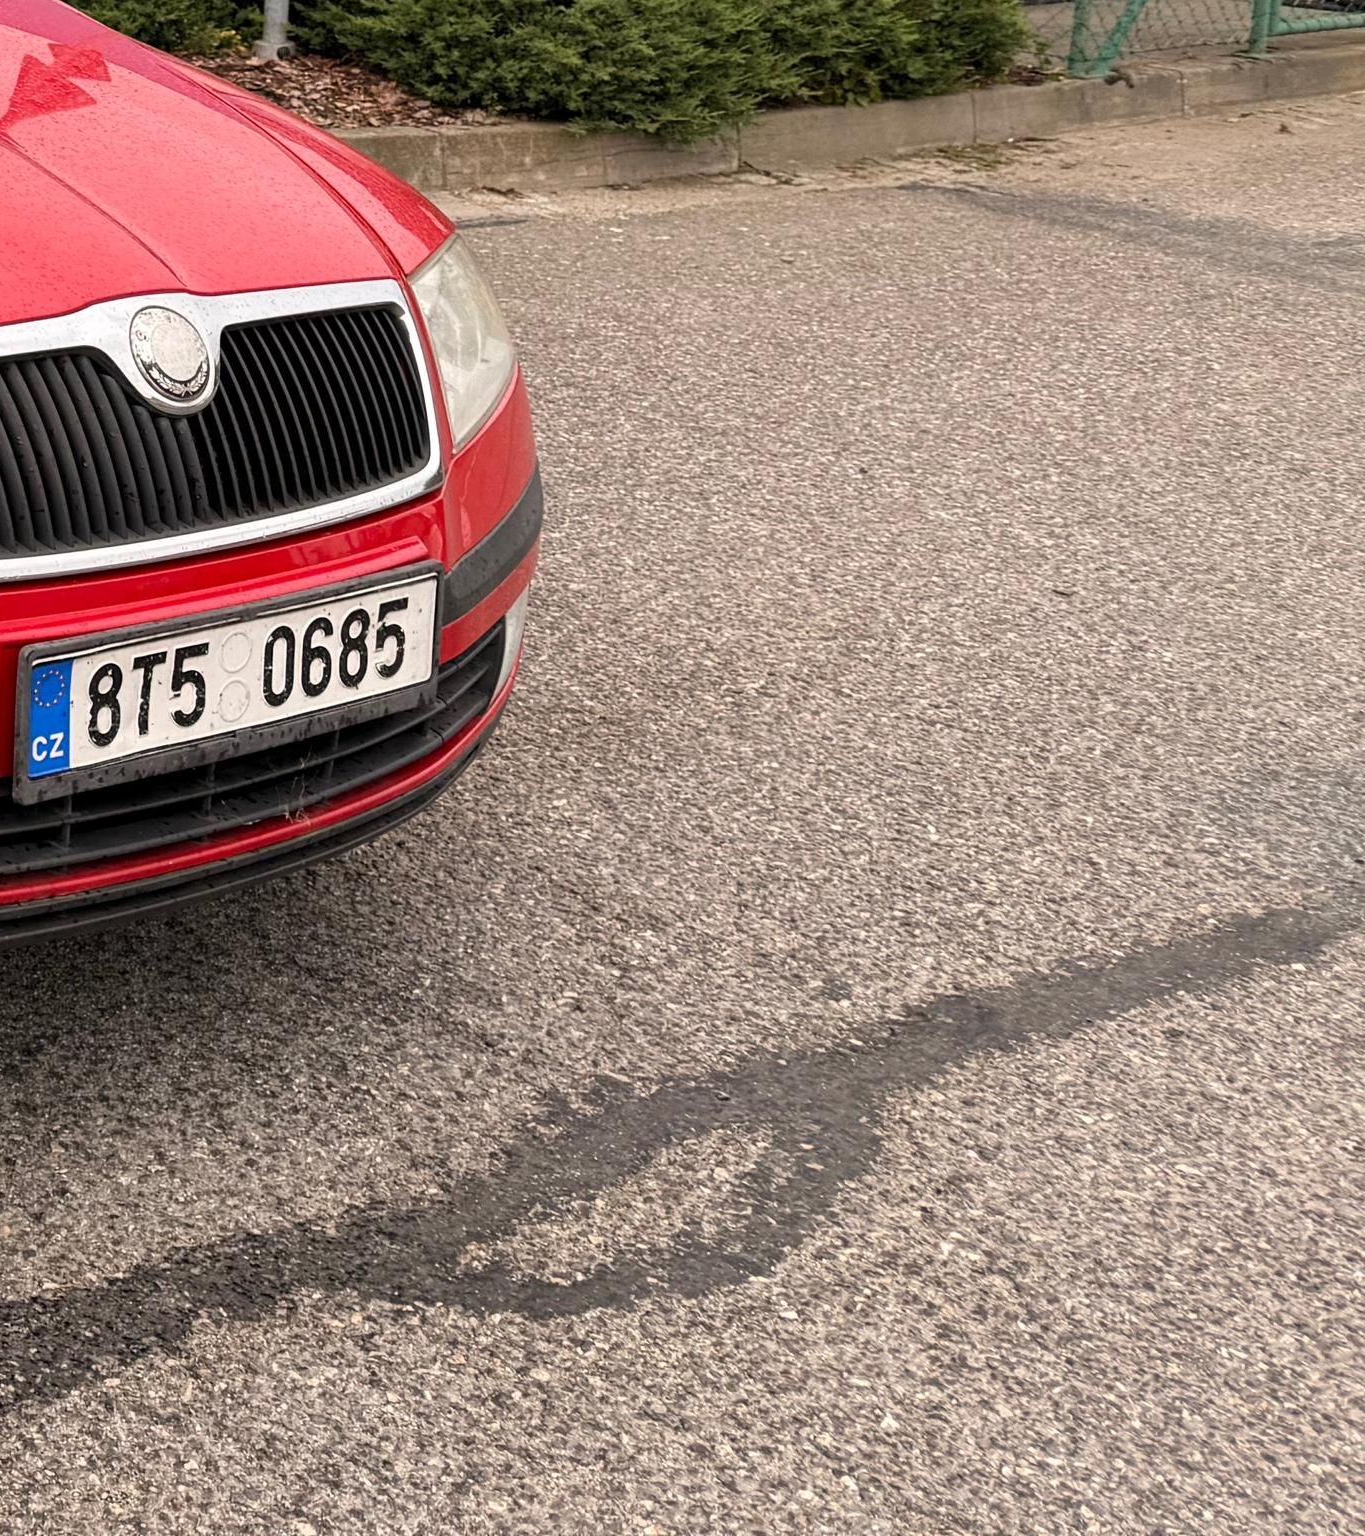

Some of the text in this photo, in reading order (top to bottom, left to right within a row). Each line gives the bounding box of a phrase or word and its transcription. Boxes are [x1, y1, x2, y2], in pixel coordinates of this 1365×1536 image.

[87, 596, 410, 747] 8T5 0685
[32, 735, 65, 763] CZ
